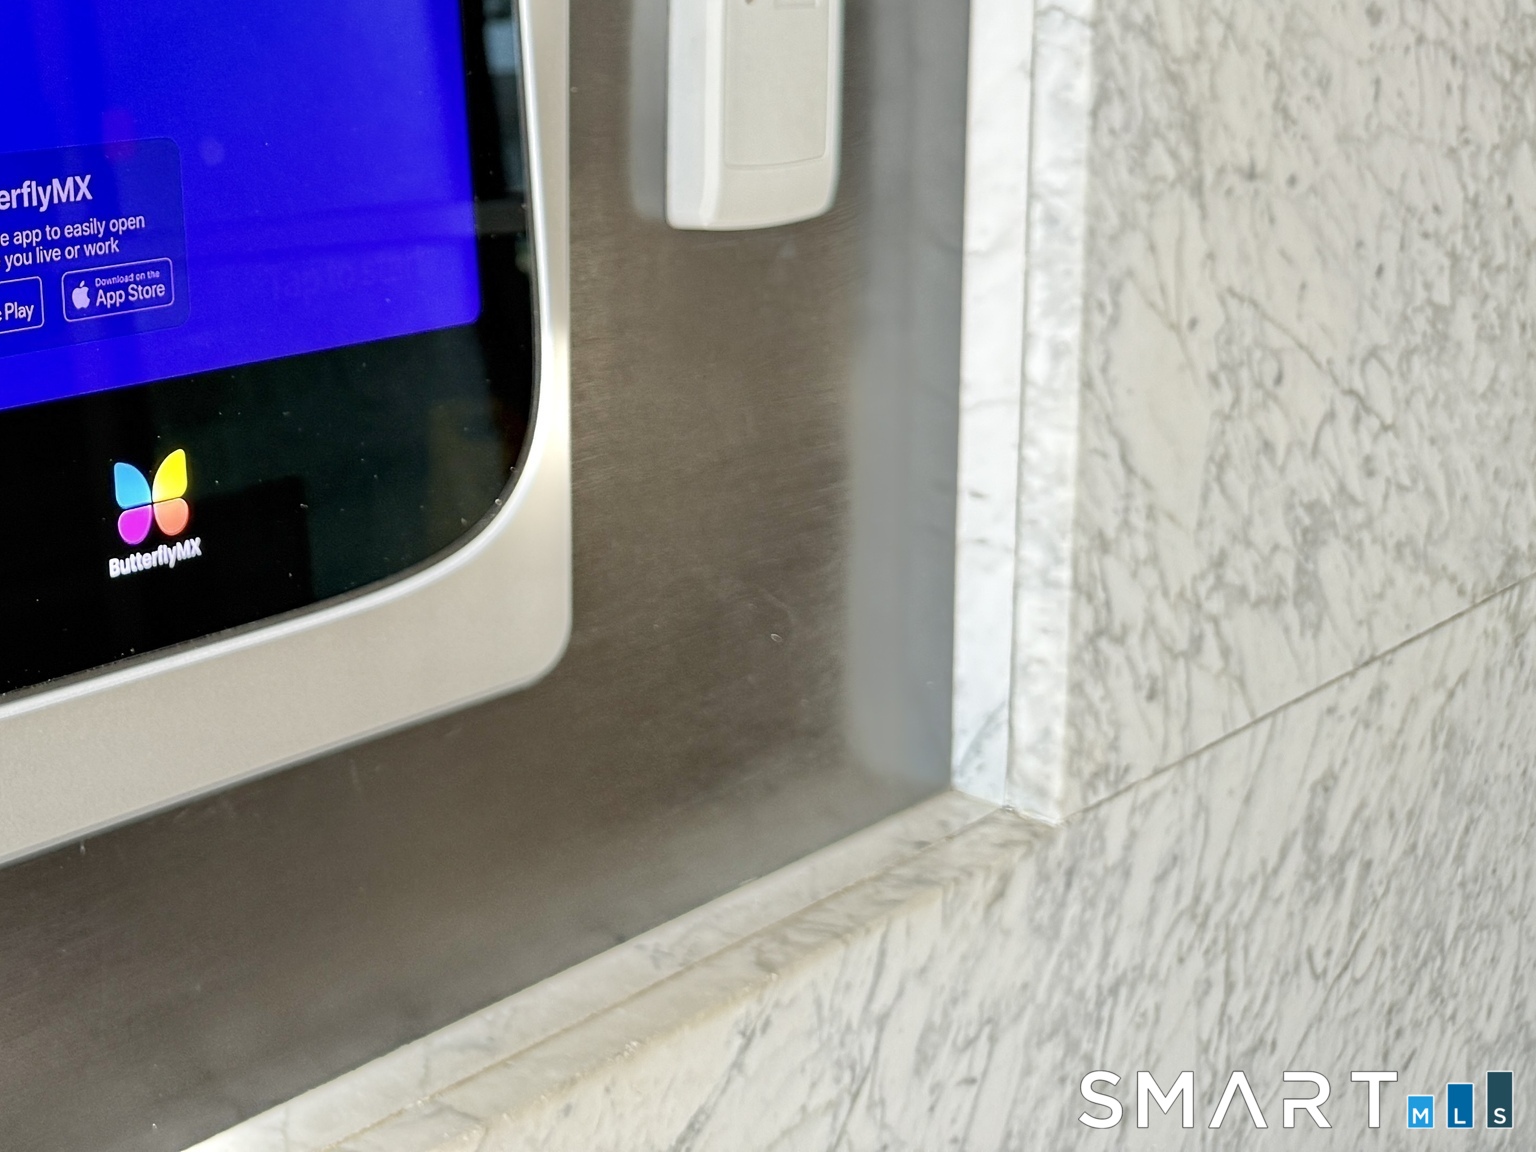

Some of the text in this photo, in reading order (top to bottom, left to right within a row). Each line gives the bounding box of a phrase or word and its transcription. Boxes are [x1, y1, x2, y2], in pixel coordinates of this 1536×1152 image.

[13, 228, 42, 248] app
[45, 225, 61, 240] to
[64, 217, 105, 238] easily
[109, 215, 145, 235] open
[4, 251, 33, 272] you
[36, 246, 61, 263] live
[64, 244, 80, 259] or
[83, 237, 119, 257] work
[95, 270, 160, 287] Download on the
[96, 283, 165, 308] App Store
[4, 301, 34, 322] Play
[108, 537, 202, 578] ButterflyMX
